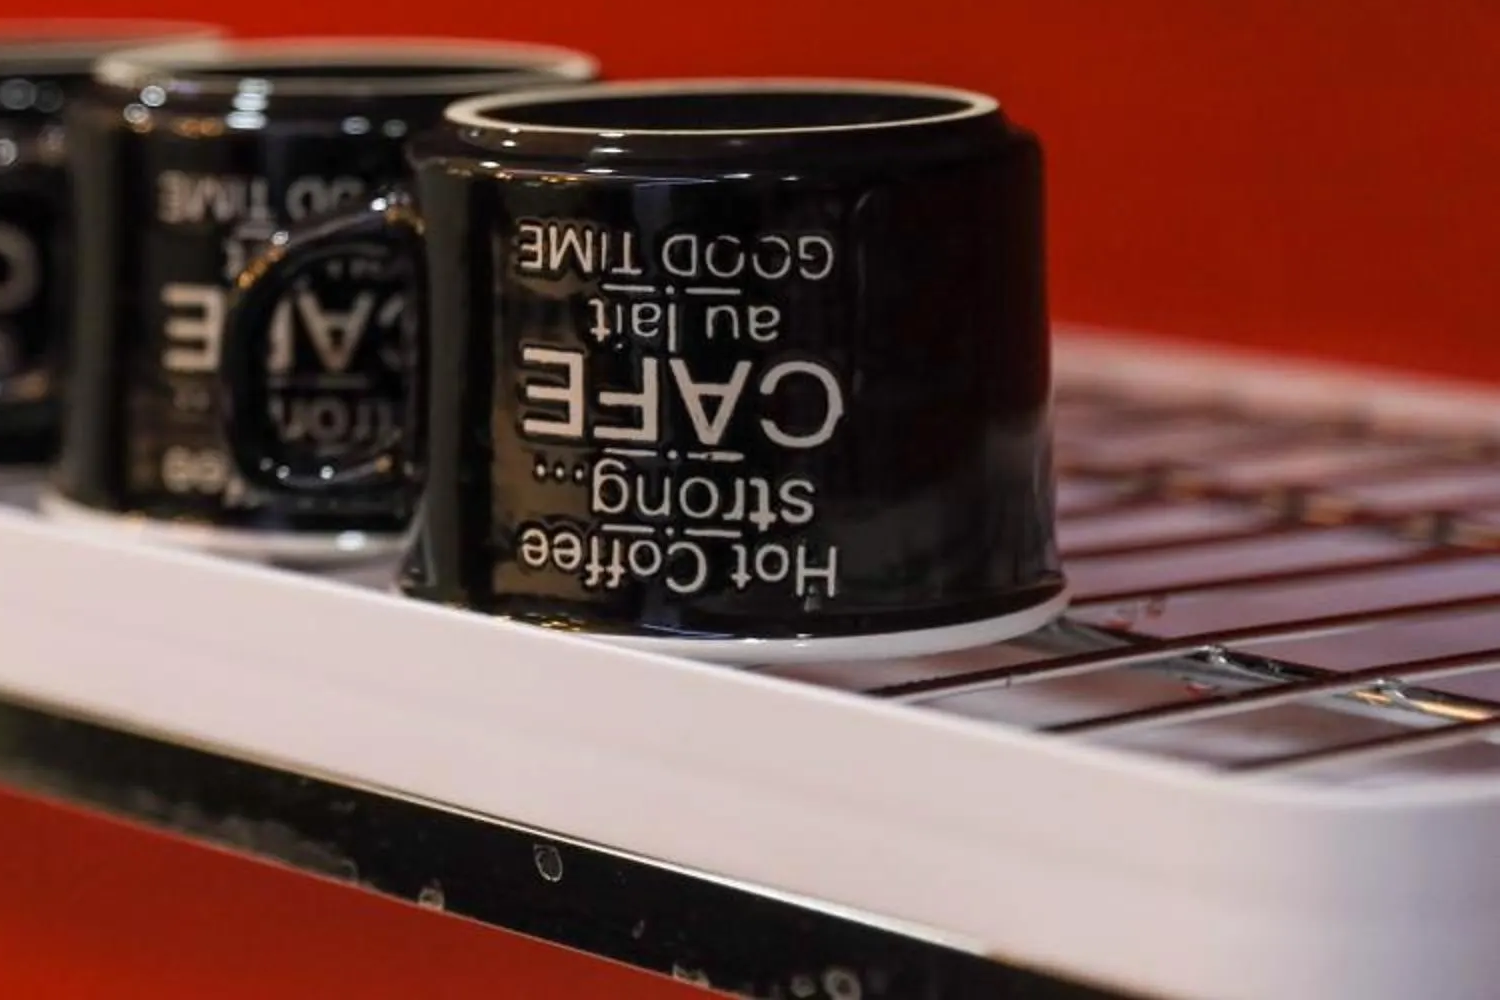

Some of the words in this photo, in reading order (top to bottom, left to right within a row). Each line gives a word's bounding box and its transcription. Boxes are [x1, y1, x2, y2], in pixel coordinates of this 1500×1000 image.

[518, 223, 644, 276] TIME
[661, 233, 835, 280] GOOD
[588, 298, 677, 353] lait
[705, 304, 781, 343] au
[522, 347, 845, 448] CAFE
[519, 529, 708, 593] Coffee
[731, 543, 839, 597] Hot
